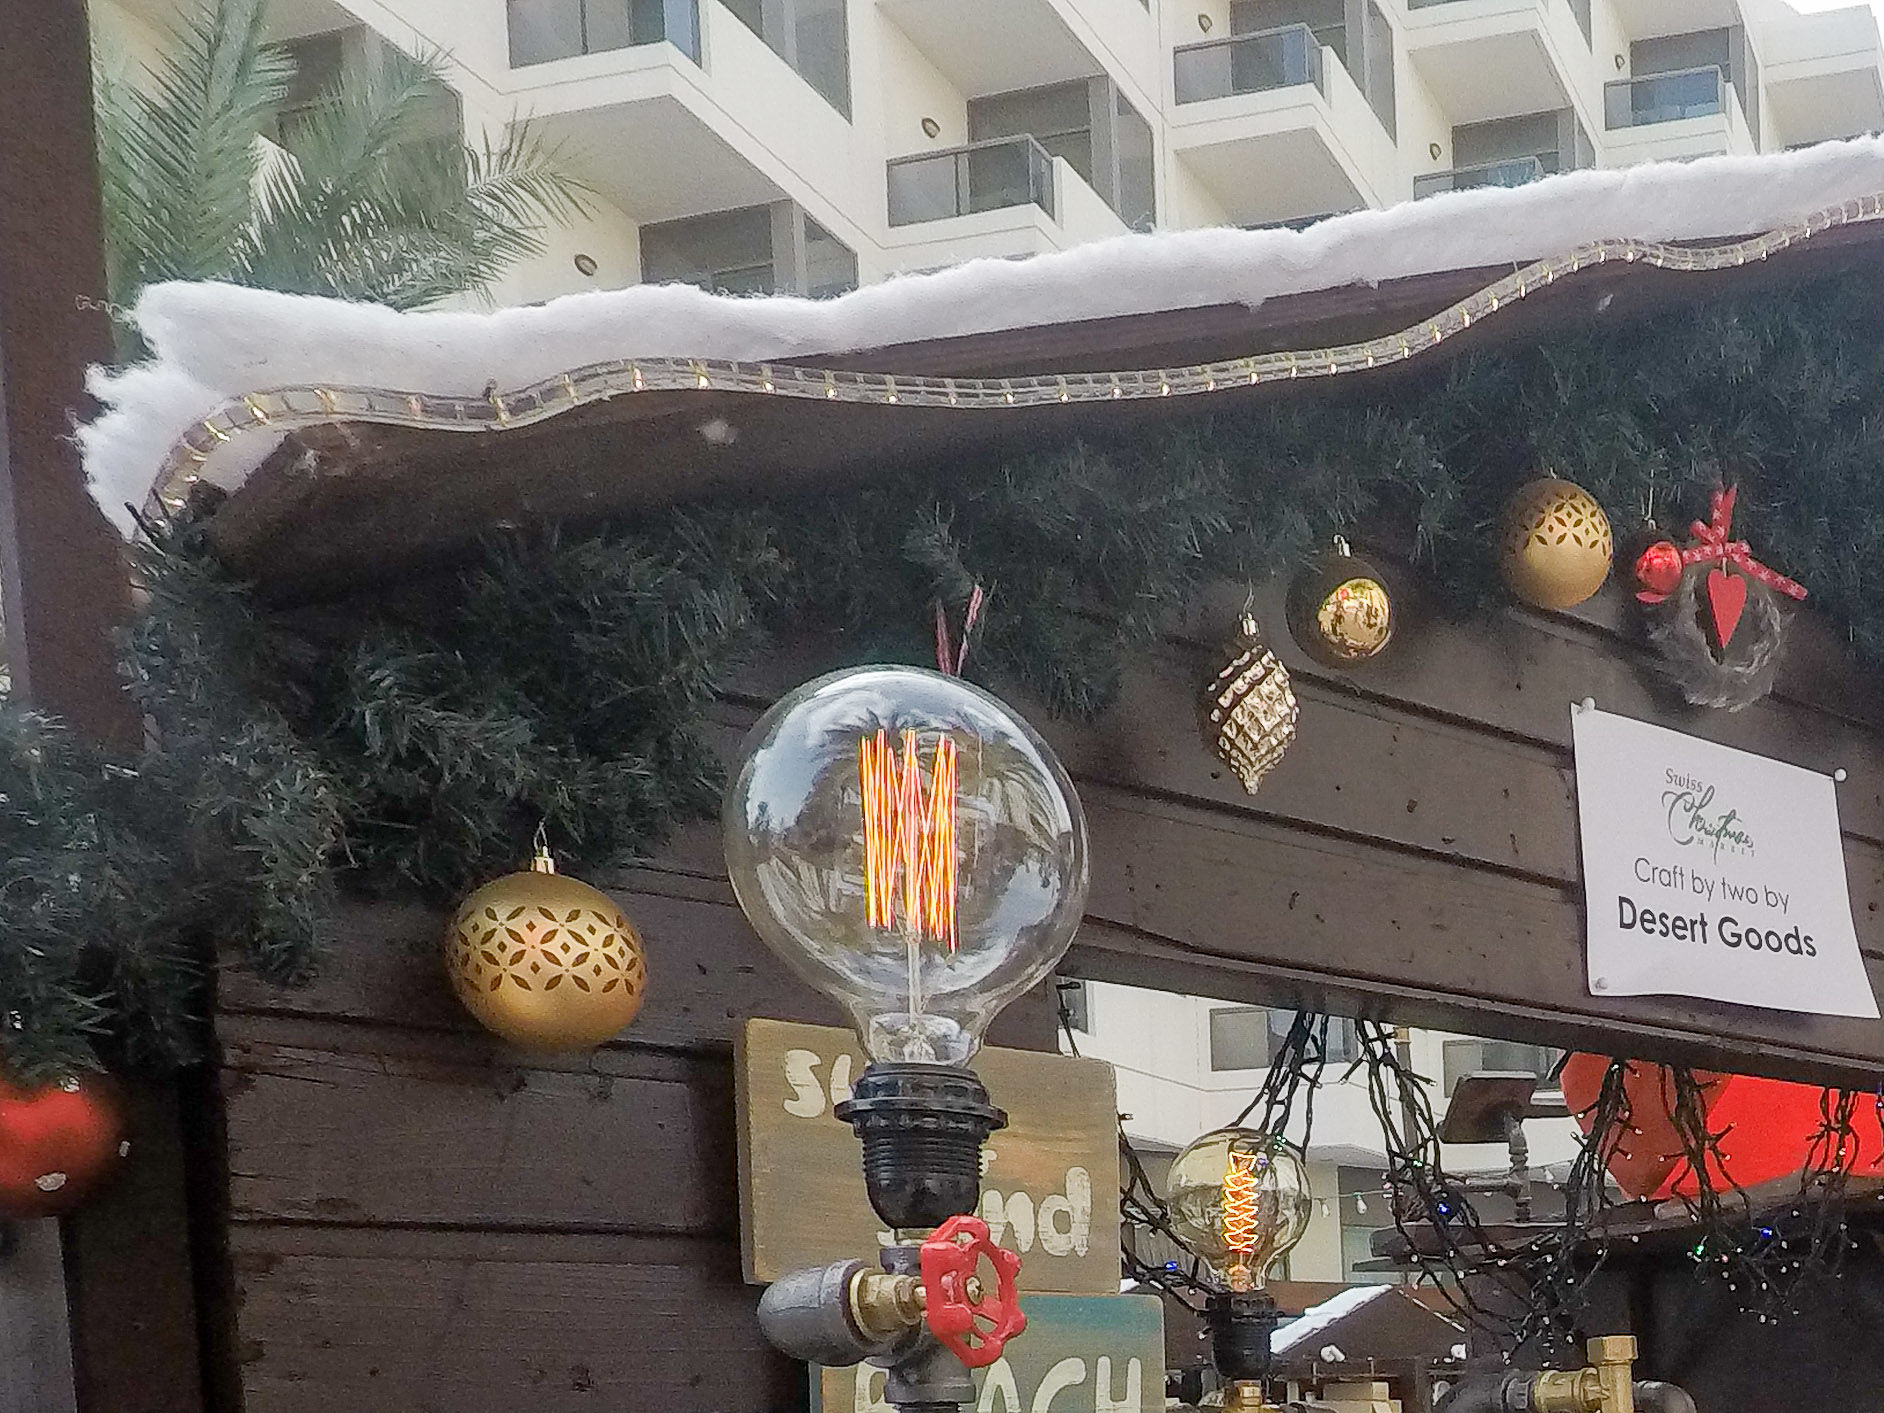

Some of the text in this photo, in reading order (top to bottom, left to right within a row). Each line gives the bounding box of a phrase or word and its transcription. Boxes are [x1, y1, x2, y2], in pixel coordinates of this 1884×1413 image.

[1665, 768, 1703, 793] Swiss
[1661, 785, 1755, 865] Christmas
[1634, 857, 1790, 915] Craft by two by
[1618, 895, 1818, 958] Desert Goods
